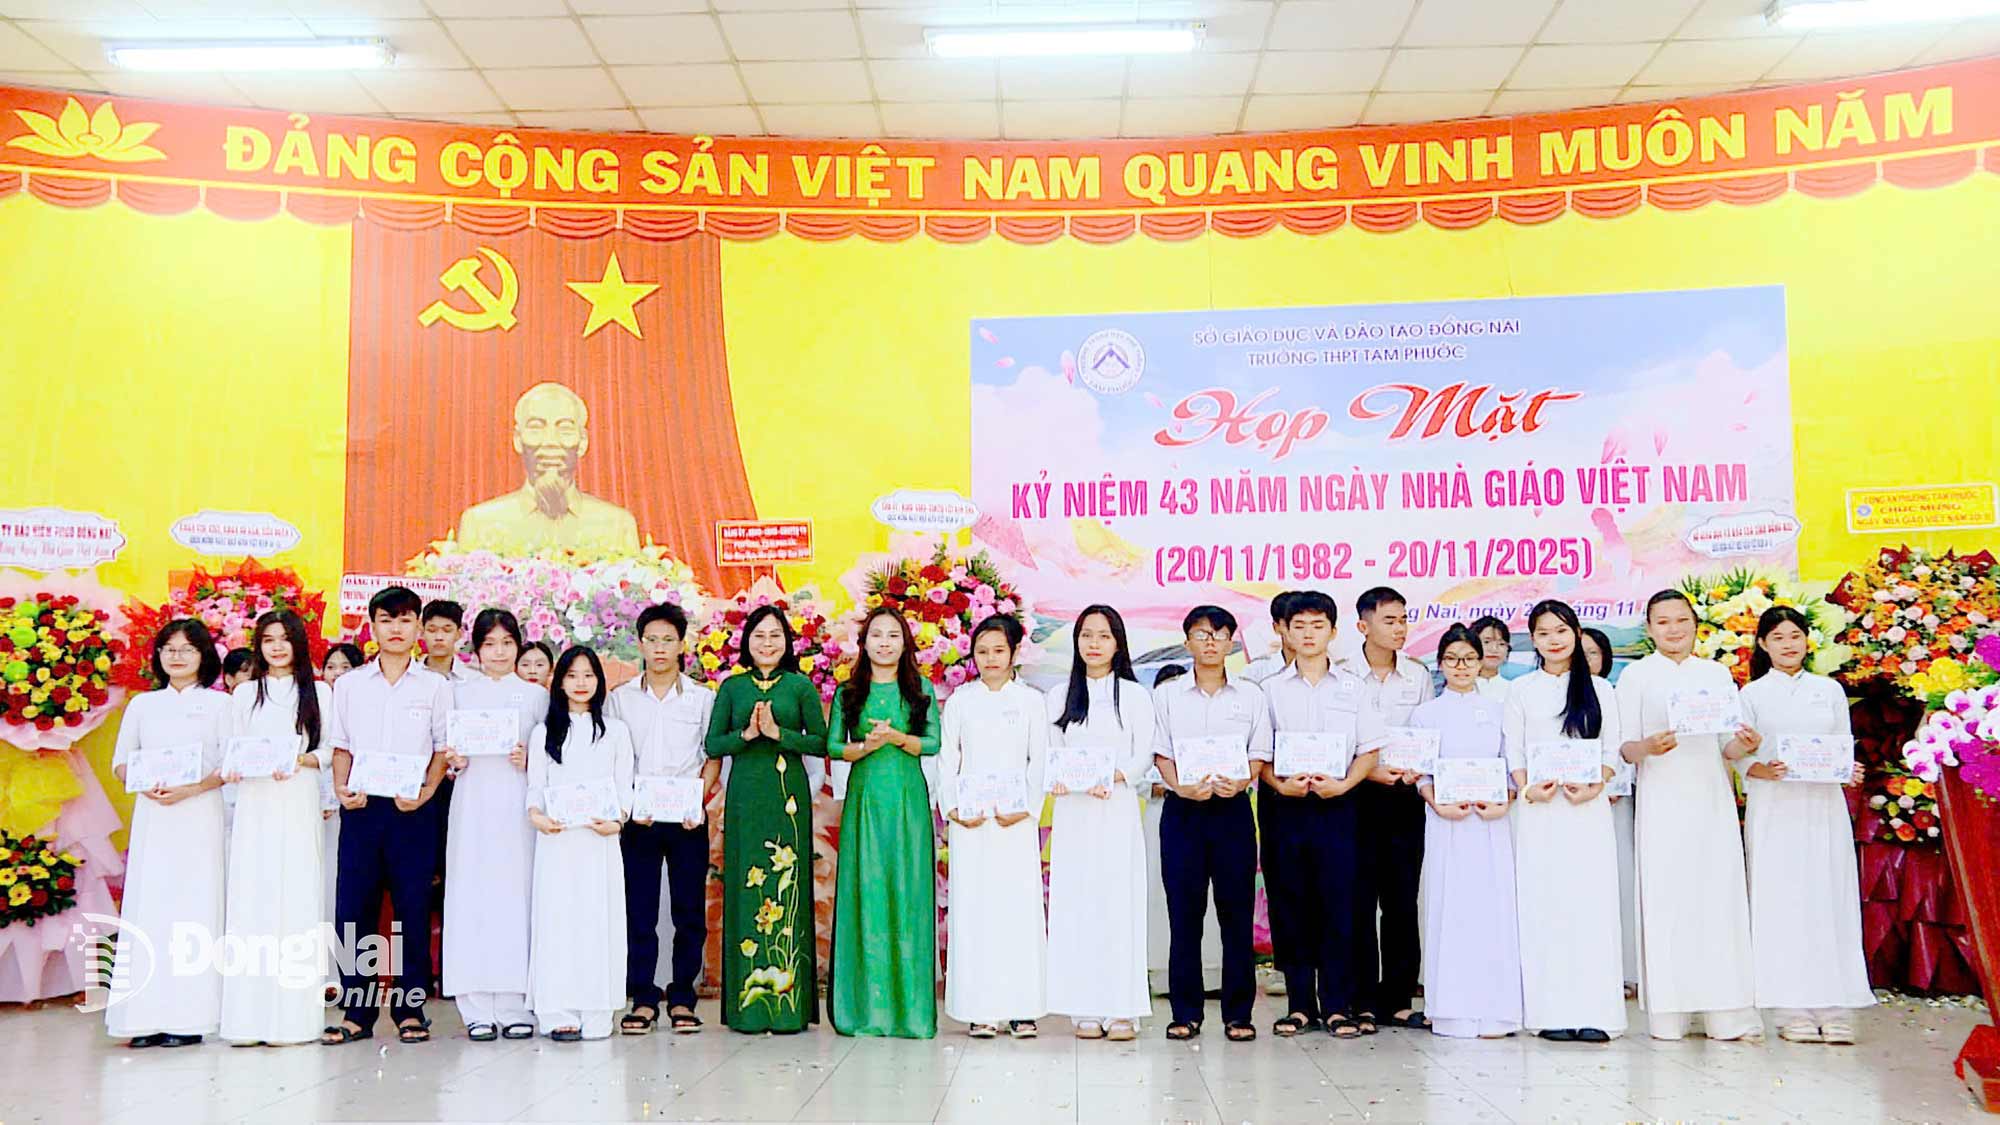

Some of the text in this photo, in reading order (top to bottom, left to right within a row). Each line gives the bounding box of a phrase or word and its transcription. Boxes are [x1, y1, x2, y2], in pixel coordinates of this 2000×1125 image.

[223, 86, 1954, 206] ĐẢNG CỘNG SẢN VIỆT NAM QUANG VINH MUÔN NĂM
[1194, 315, 1520, 345] SỞ GIÁO DỤC VÀ ĐÀO TẠO ĐỒNG NAI
[1250, 343, 1466, 365] TRƯỜNG THPT TAM PHƯỚC
[1153, 382, 1584, 461] Họp Mặt
[1012, 458, 1747, 525] KỶ NIỆM 43 NĂM NGÀY NHÀ GIÁO VIỆT NAM
[1155, 537, 1593, 587] (20/11/1982 - 20/11/2025)
[1426, 603, 1461, 620] Nai,
[1469, 602, 1516, 620] ngày
[1524, 603, 1537, 617] 2
[1616, 602, 1635, 616] 11
